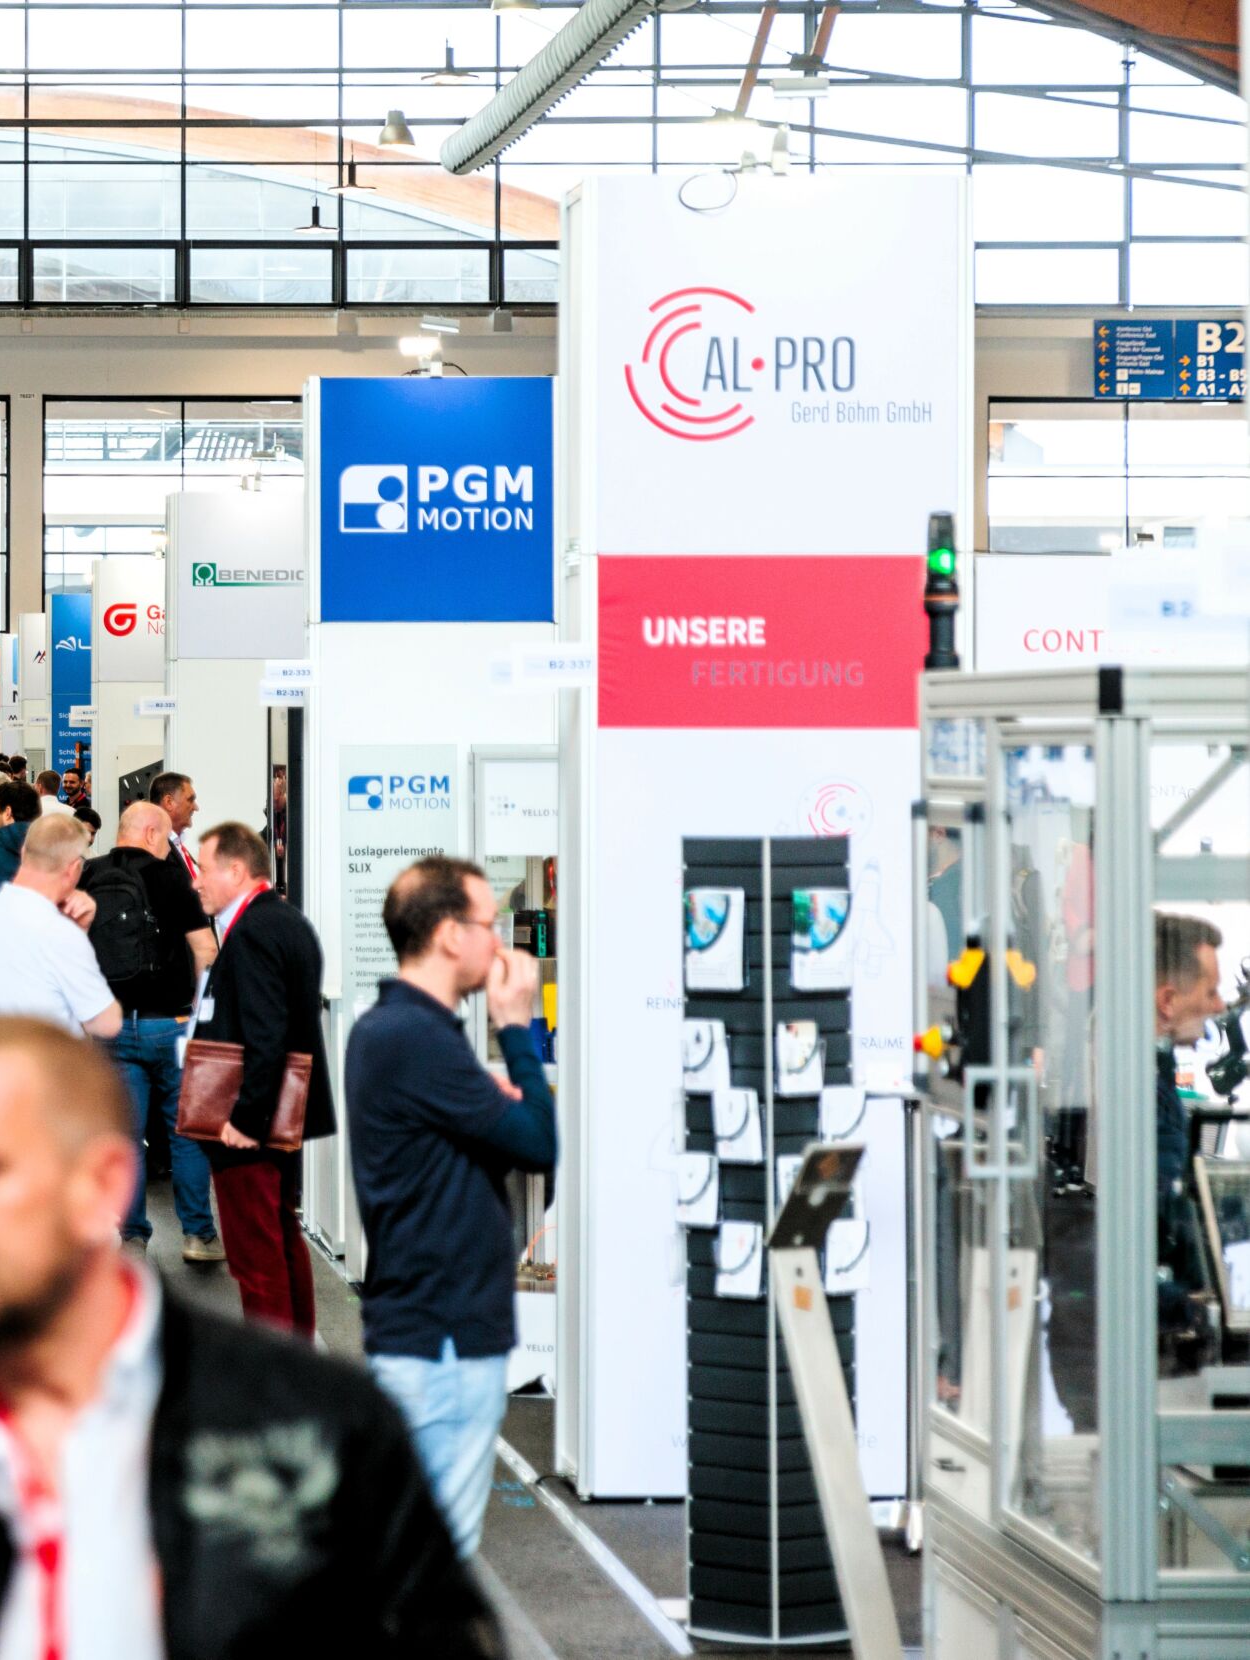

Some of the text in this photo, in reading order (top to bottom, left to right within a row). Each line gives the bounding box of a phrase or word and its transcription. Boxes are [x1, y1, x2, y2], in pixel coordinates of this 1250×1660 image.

[1197, 322, 1245, 354] B2
[1196, 354, 1215, 368] B1
[1196, 368, 1216, 382] B3
[1196, 383, 1216, 396] A1
[792, 402, 932, 424] Gerd Böhm GmbH
[418, 464, 534, 503] PGM
[418, 508, 534, 531] MOTION
[218, 570, 304, 581] BENEDIC
[643, 616, 766, 646] UNSERE
[692, 661, 865, 687] FERTIGUNG
[388, 775, 450, 794] PGM
[388, 797, 450, 810] MOTION
[522, 809, 550, 817] YELLO
[348, 846, 444, 858] Loslagerelemente
[348, 864, 372, 874] SLIX
[355, 946, 384, 954] Montage
[526, 1344, 554, 1352] YELLO
